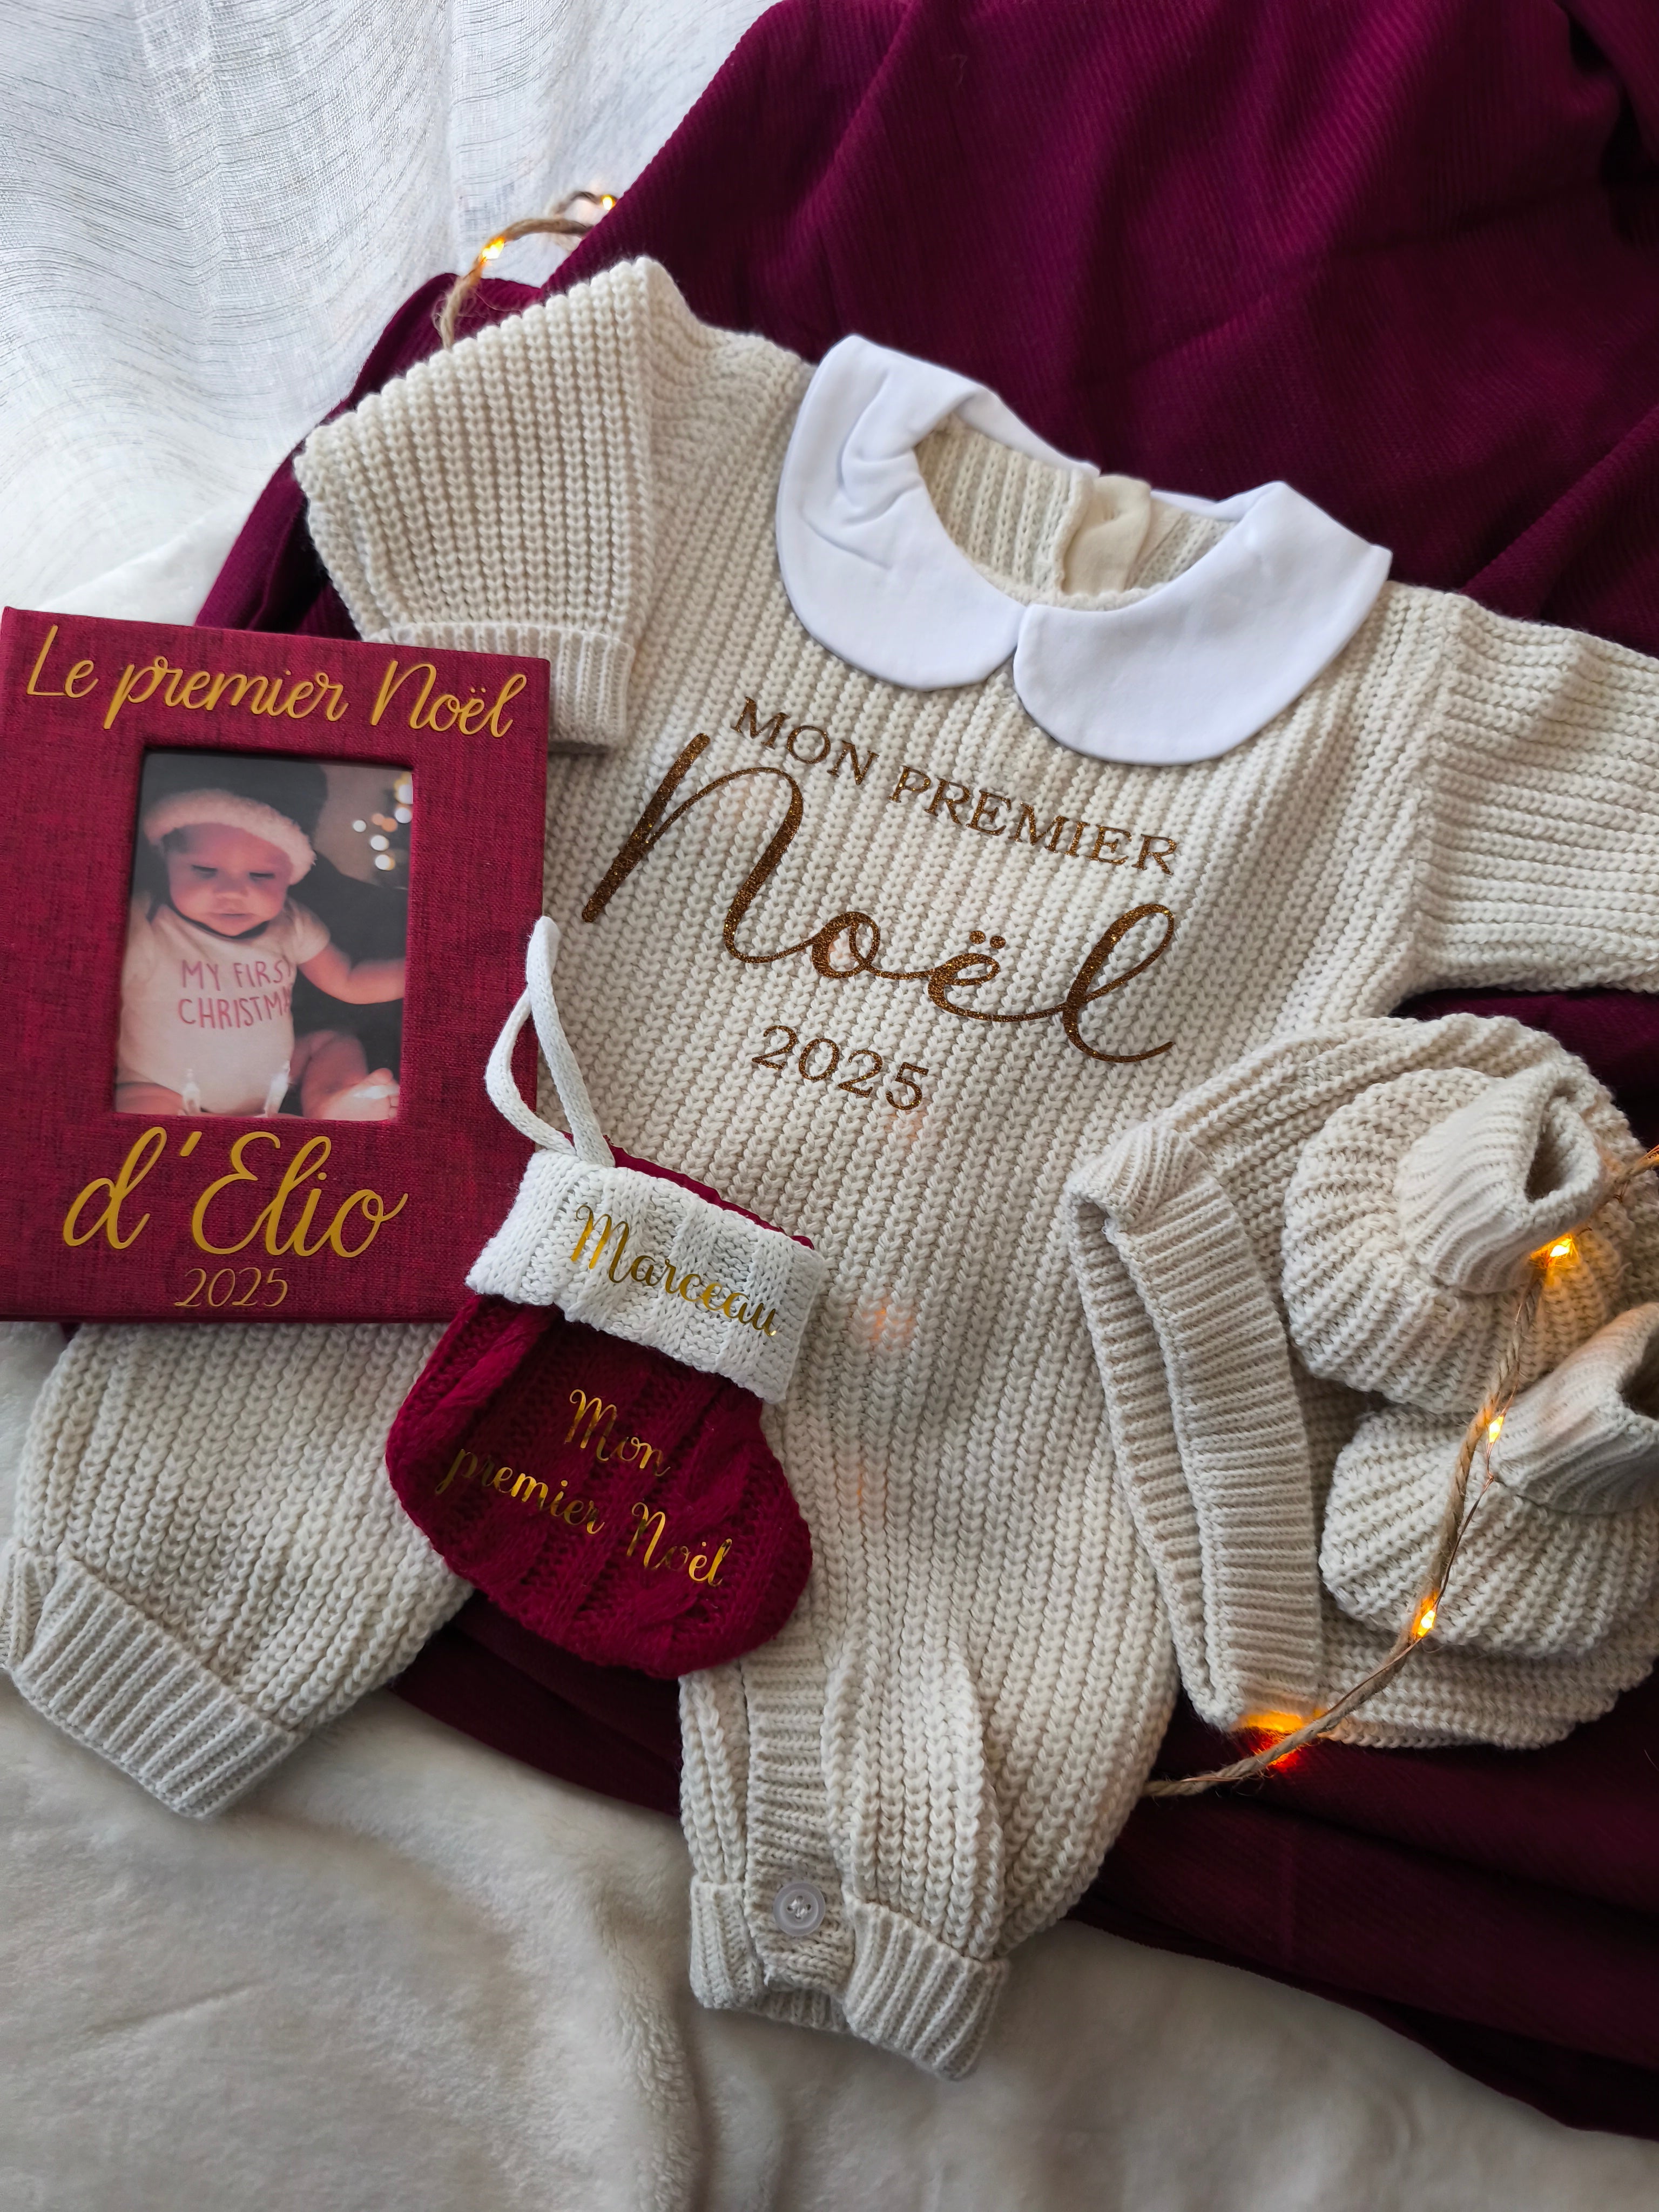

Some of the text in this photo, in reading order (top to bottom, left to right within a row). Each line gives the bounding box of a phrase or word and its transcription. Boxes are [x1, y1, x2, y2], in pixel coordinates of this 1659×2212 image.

[26, 625, 527, 738] Le premier Noël
[732, 696, 1178, 876] MON PREMIER
[582, 733, 1175, 1063] Noël
[180, 959, 221, 991] MY
[752, 1026, 929, 1110] 2025
[174, 1267, 288, 1307] 2025
[571, 1205, 778, 1337] Marceau
[564, 1389, 671, 1477] Mon
[435, 1449, 605, 1535] premier
